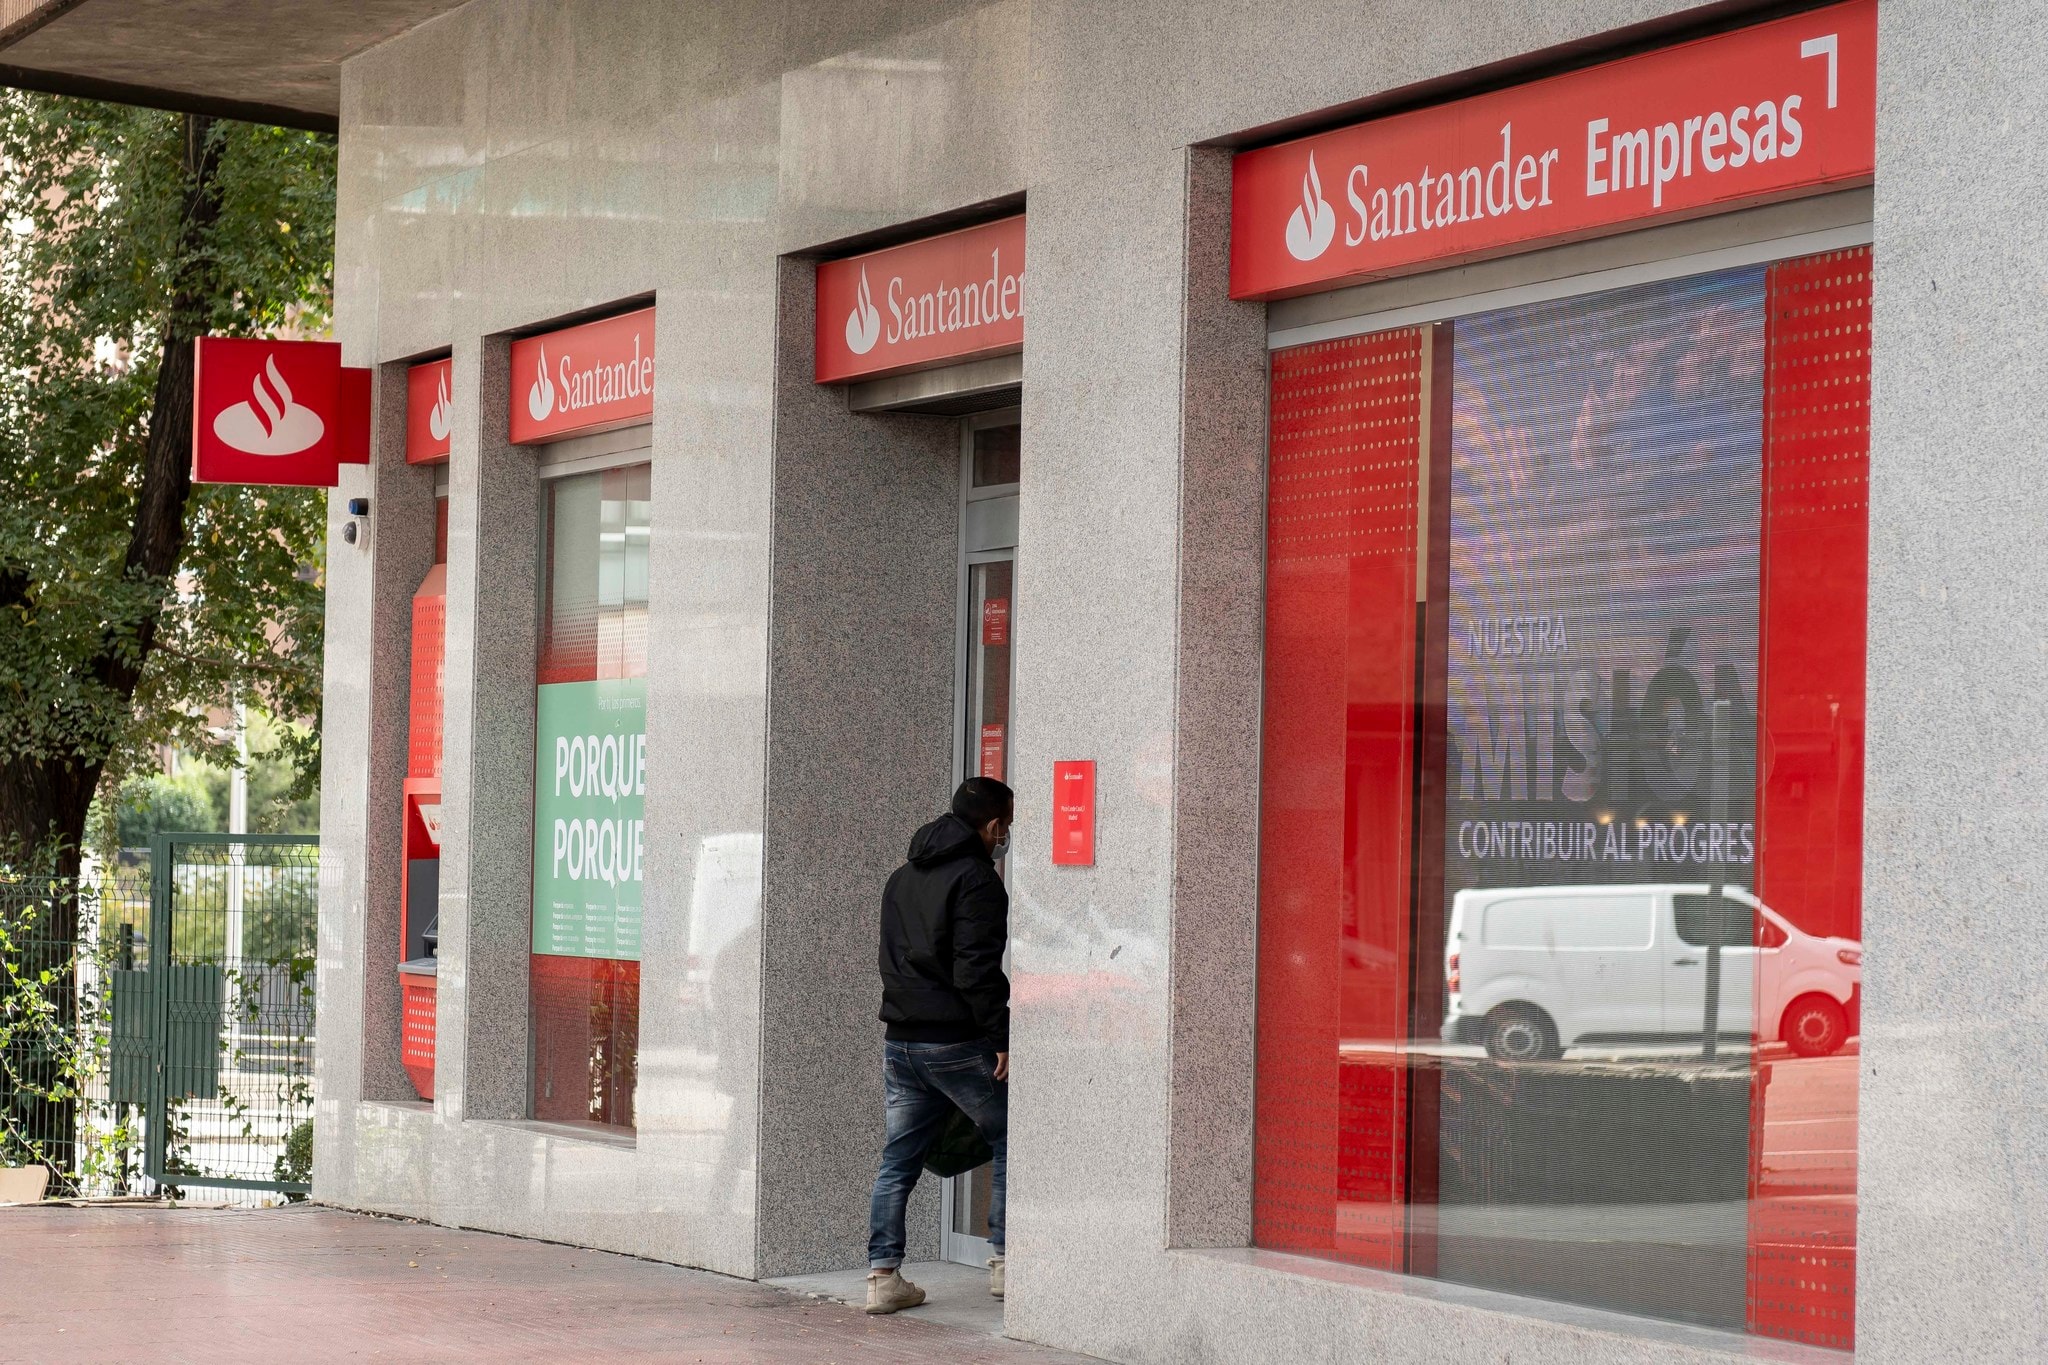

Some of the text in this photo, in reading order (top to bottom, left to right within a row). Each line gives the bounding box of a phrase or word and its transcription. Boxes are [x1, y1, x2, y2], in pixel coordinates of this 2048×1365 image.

[1345, 95, 1802, 246] Santander Empresas
[558, 333, 655, 413] Santande
[1467, 616, 1568, 658] NUESTRA
[555, 734, 645, 805] PORQUE
[553, 818, 643, 889] PORQUE
[1458, 821, 1754, 864] CONTRIBUIR AL PROGRES
